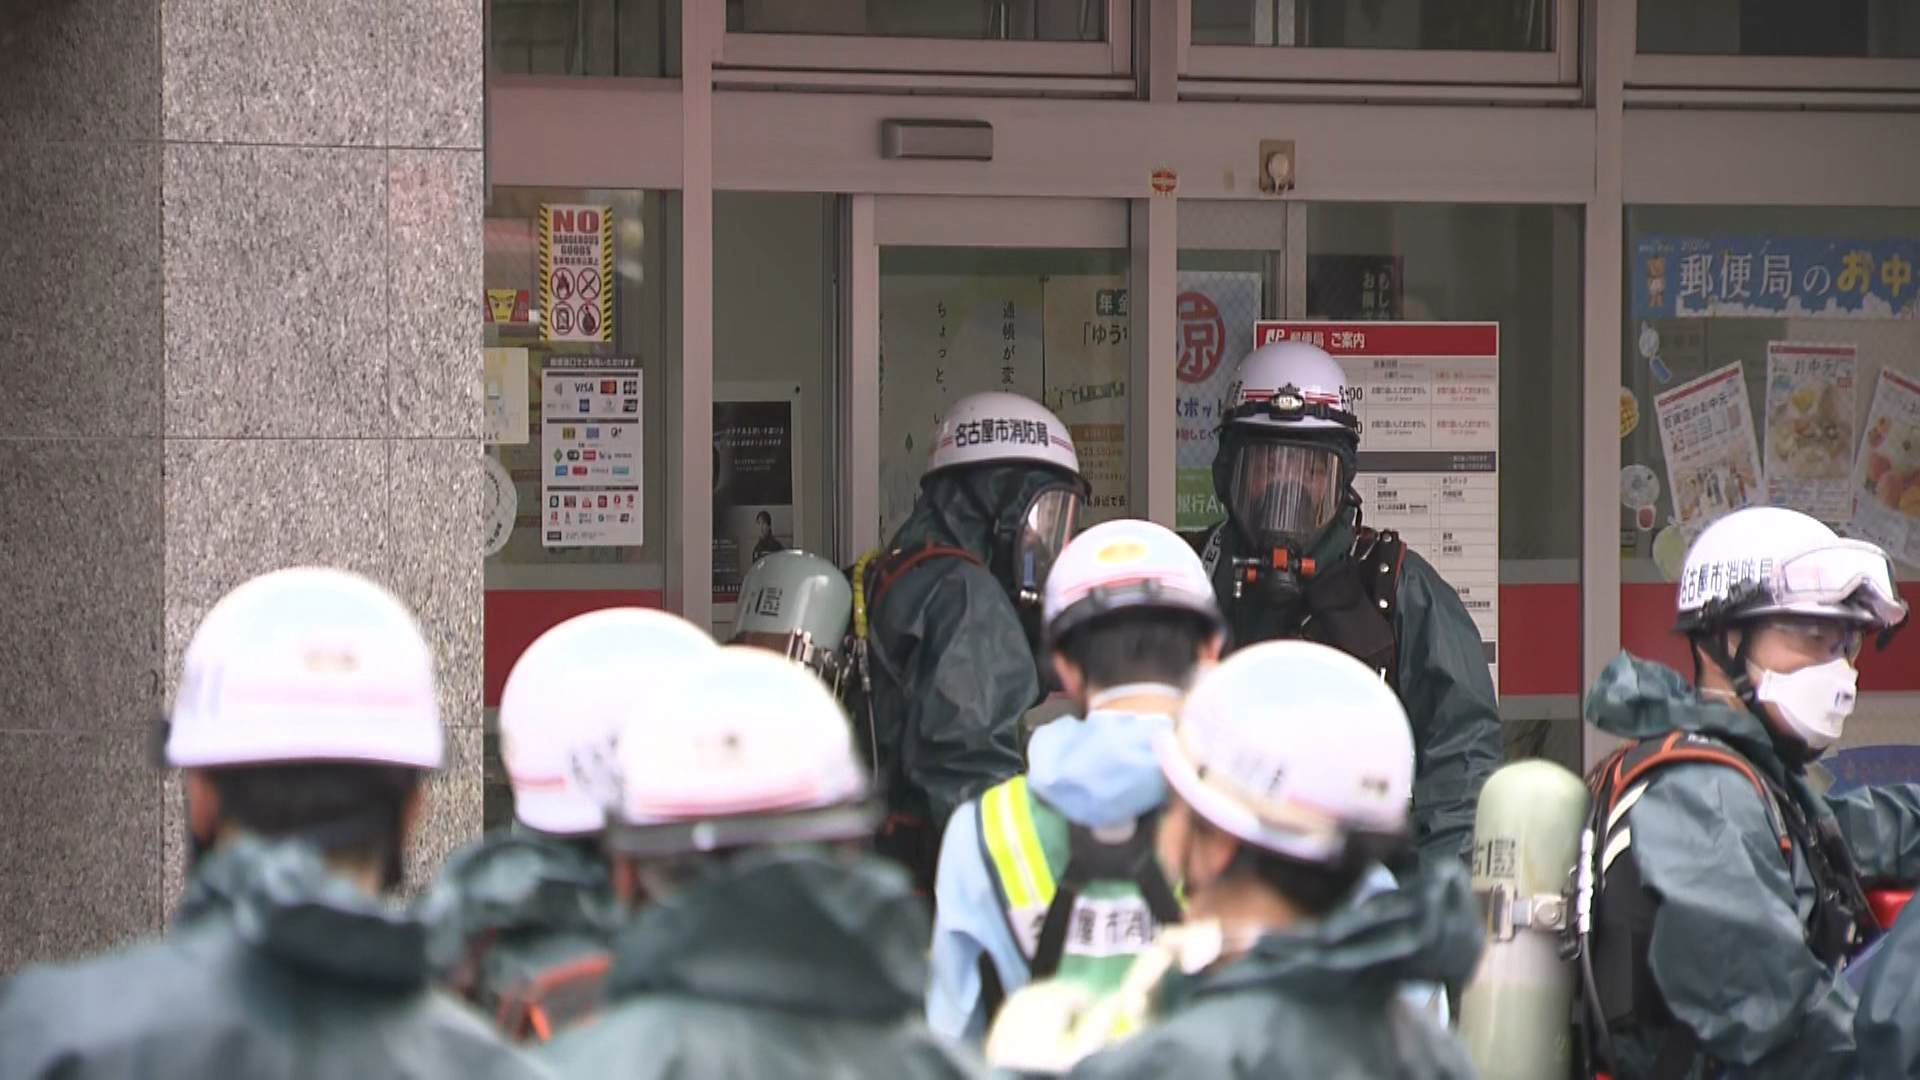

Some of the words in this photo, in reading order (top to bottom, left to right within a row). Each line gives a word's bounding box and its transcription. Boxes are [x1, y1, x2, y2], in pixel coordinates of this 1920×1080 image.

[553, 209, 600, 234] NO
[561, 245, 591, 255] GOODS
[1002, 301, 1015, 392] 通帳が変
[1331, 331, 1365, 348] ご案内
[575, 383, 594, 392] VISA
[955, 418, 1049, 448] 名古屋市消防局
